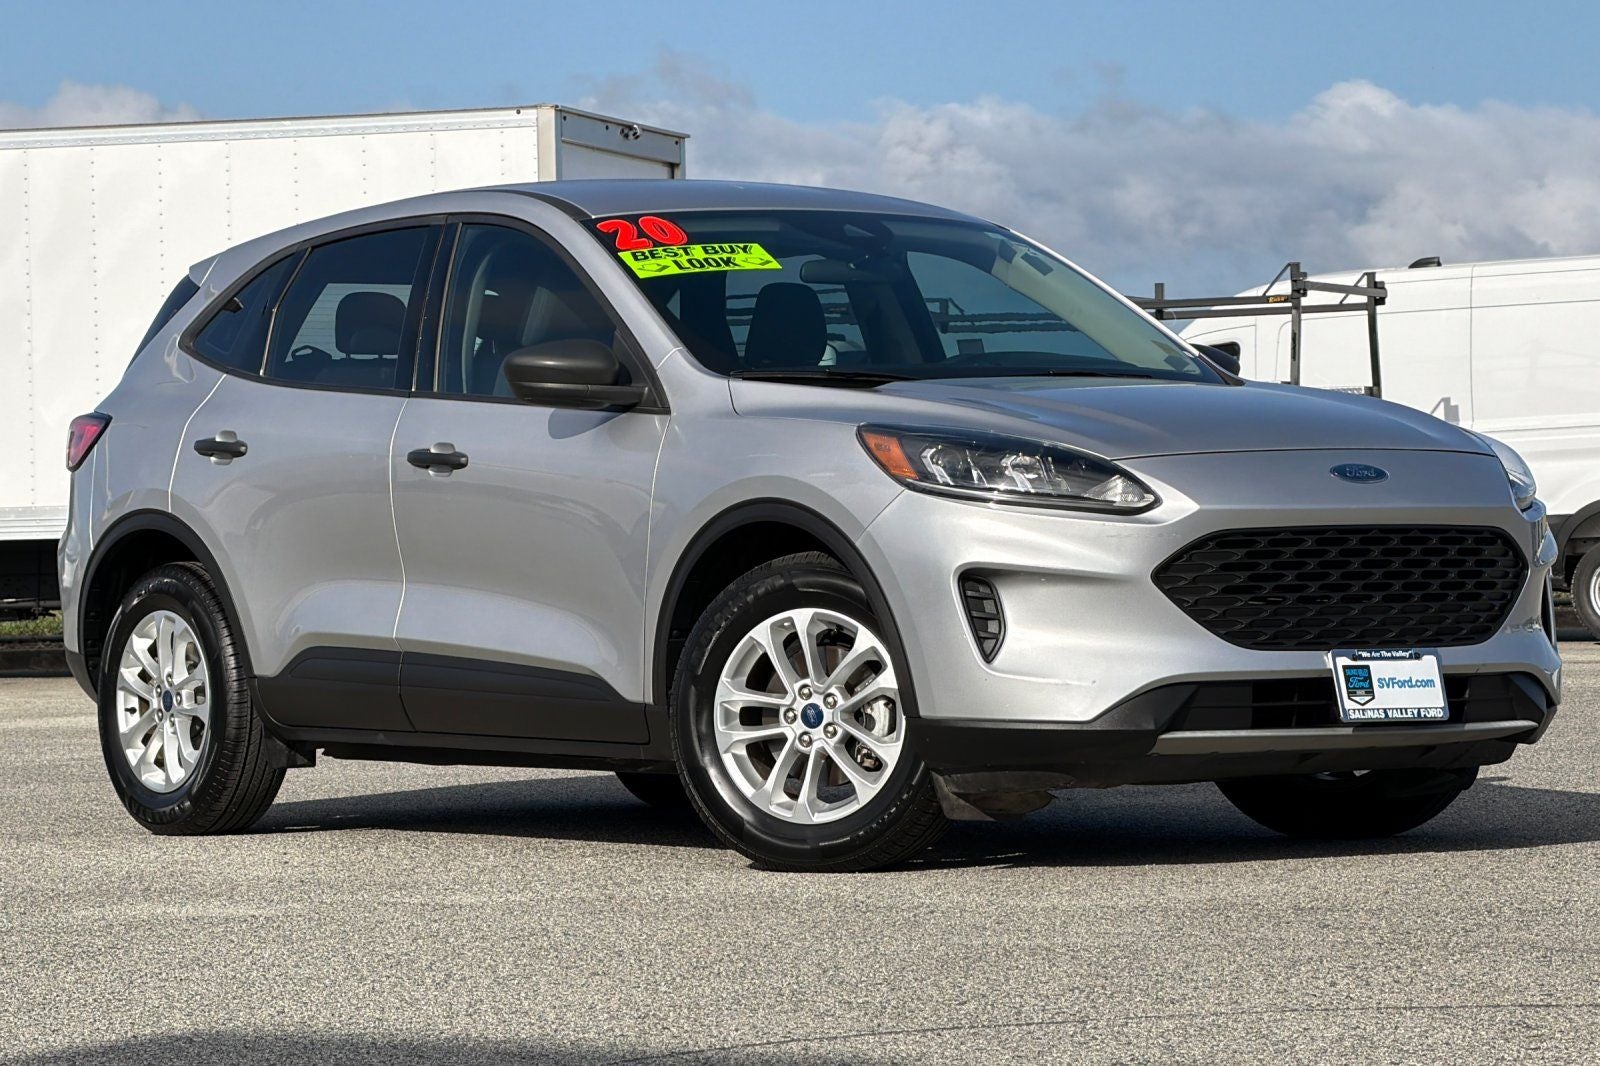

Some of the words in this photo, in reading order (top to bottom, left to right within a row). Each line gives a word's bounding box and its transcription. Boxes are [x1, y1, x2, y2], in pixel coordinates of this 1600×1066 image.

[597, 216, 688, 250] 20
[631, 246, 693, 262] BEST
[701, 244, 753, 255] BUY
[673, 257, 741, 271] LOOK
[1348, 677, 1370, 689] Ford
[1377, 677, 1436, 689] SVFord.com
[1349, 708, 1385, 719] SALINAS
[1387, 709, 1418, 718] VALLEY
[1420, 708, 1444, 718] FORD
